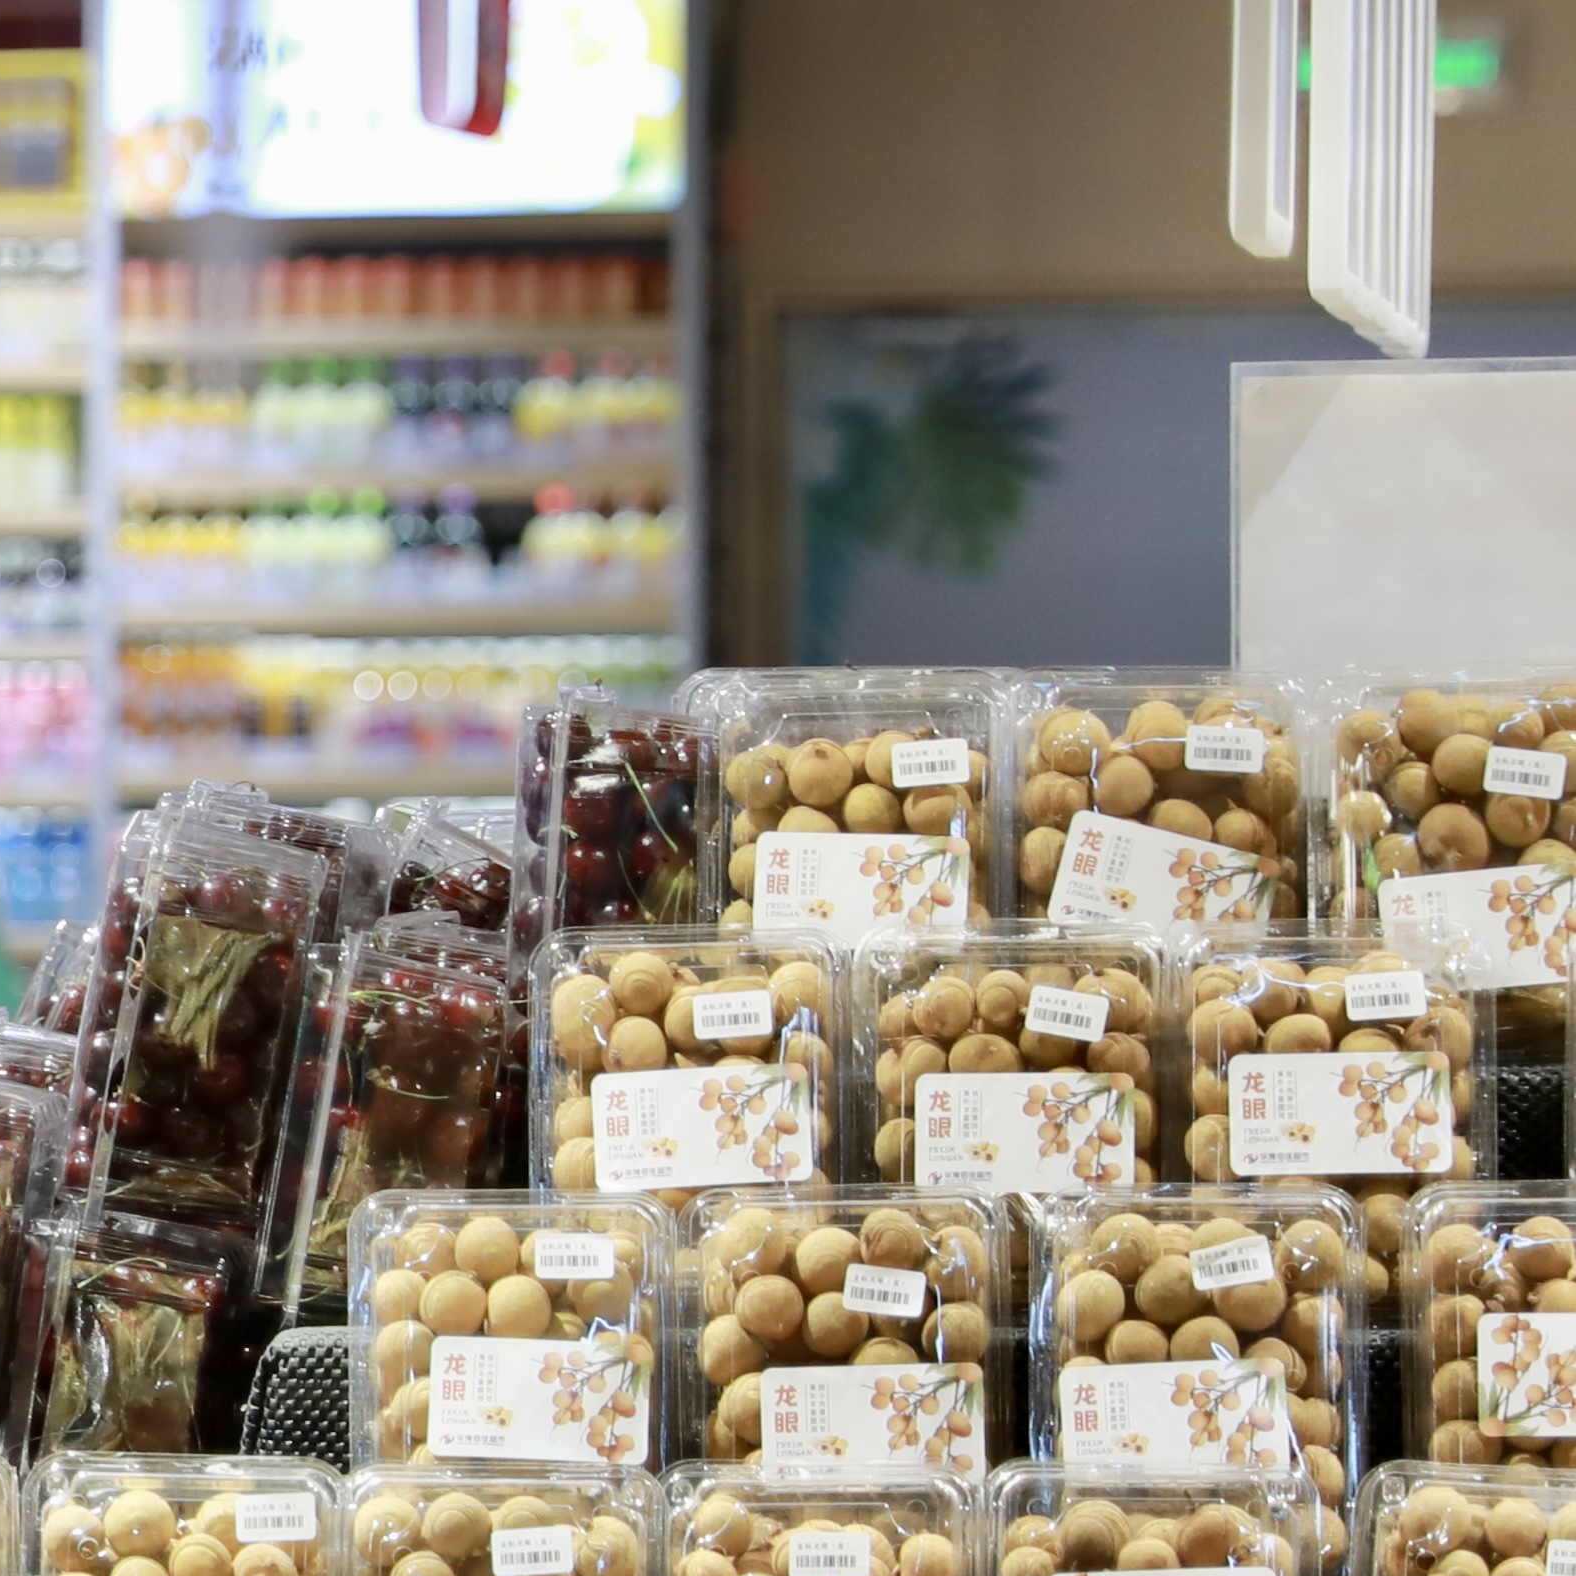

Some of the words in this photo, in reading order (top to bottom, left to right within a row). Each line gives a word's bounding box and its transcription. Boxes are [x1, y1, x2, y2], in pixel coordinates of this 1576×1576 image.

[767, 848, 791, 895] 龙眼
[1073, 828, 1106, 877] 龙眼
[605, 1089, 630, 1137] 龙眼
[928, 1090, 952, 1138] 龙眼
[1242, 1072, 1267, 1120] 龙眼
[442, 1353, 467, 1401] 龙眼
[774, 1385, 799, 1433] 龙眼
[1073, 1384, 1098, 1432] 龙眼
